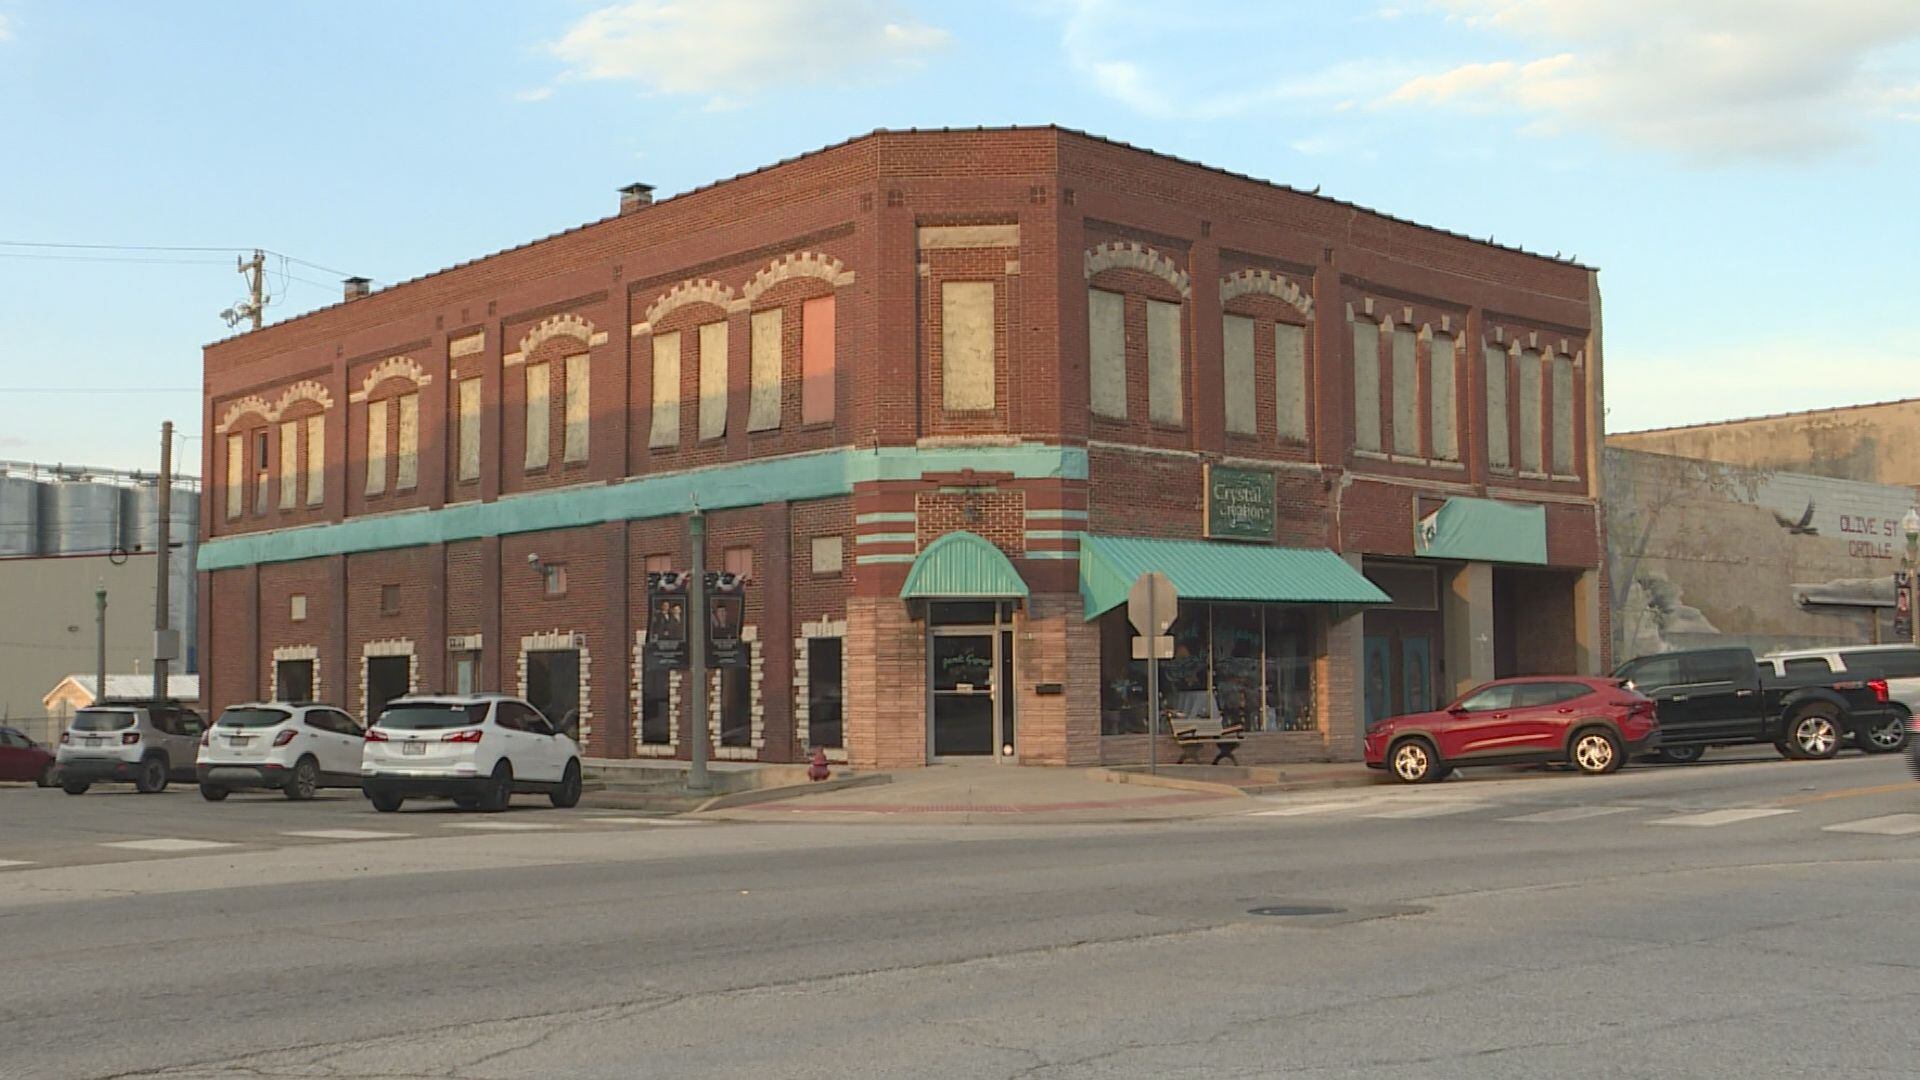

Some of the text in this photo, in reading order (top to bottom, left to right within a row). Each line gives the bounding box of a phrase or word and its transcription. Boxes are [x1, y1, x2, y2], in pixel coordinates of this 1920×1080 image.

[1213, 483, 1261, 504] Crystal
[1840, 515, 1898, 537] OLIVE ST
